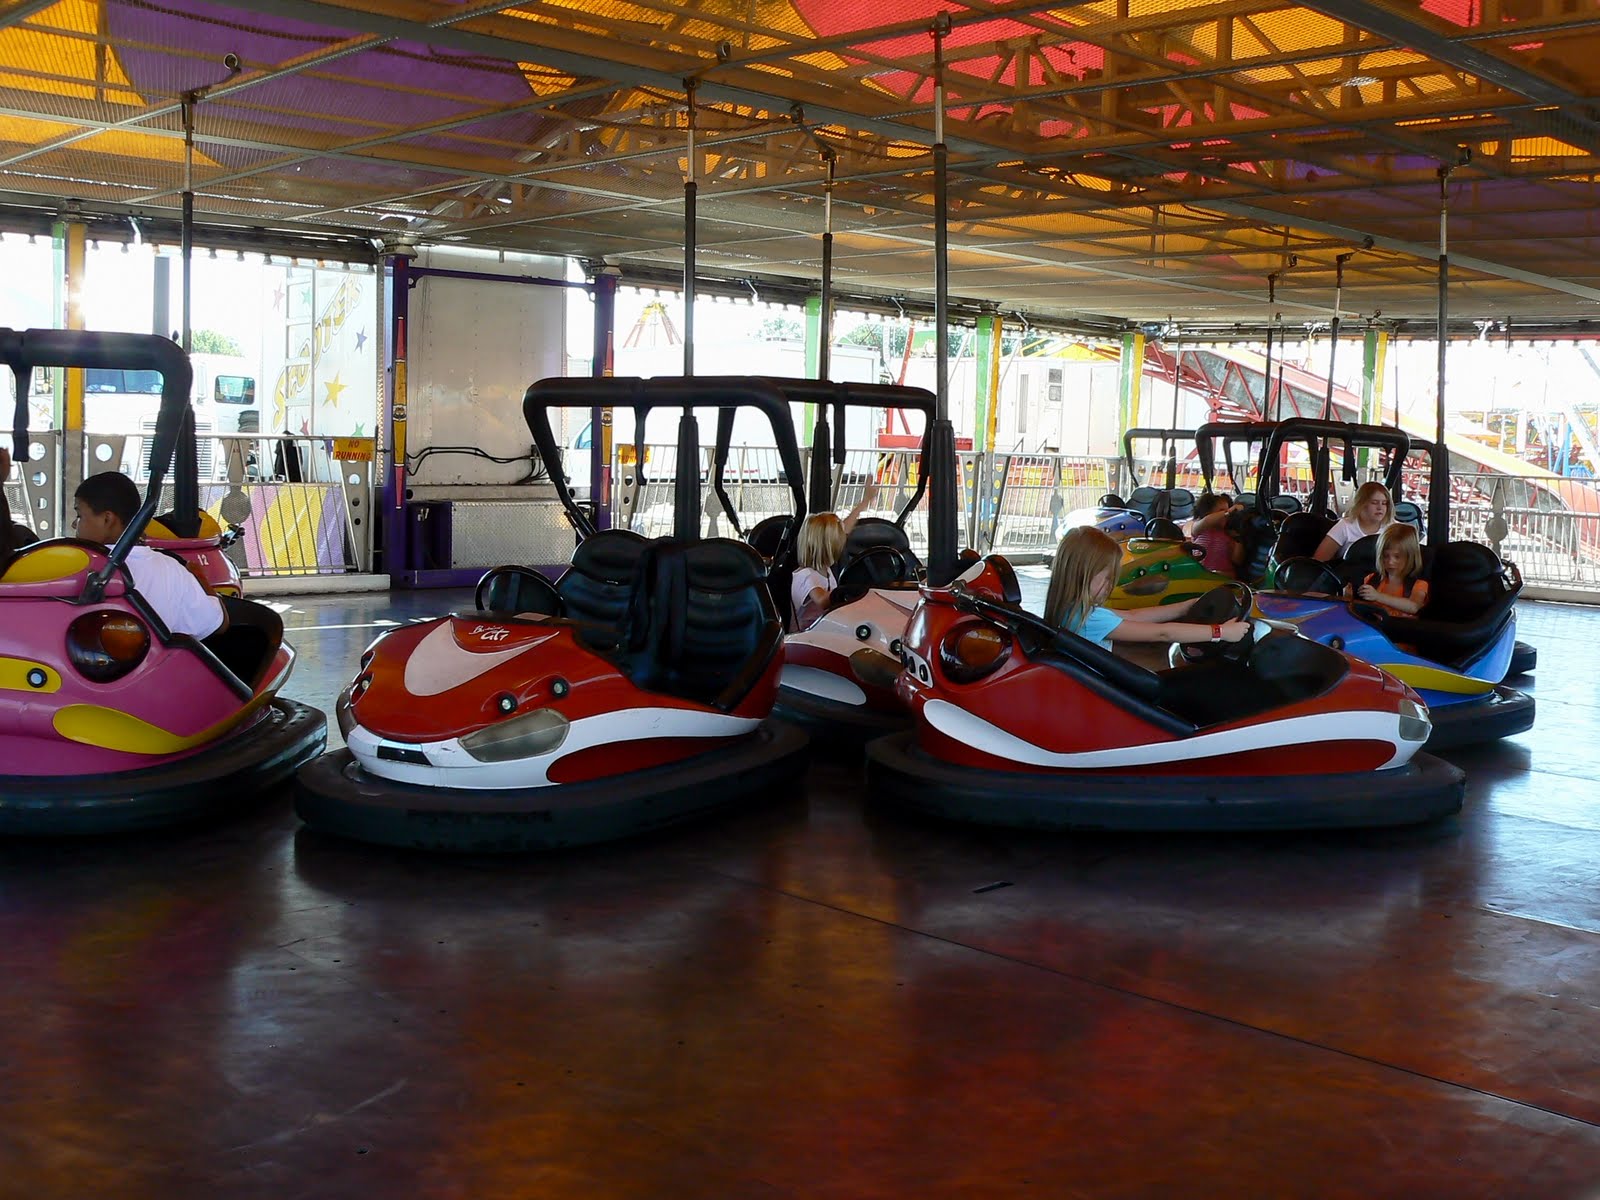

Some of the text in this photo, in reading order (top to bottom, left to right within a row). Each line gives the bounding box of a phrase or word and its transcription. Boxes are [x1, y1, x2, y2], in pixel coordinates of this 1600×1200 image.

[348, 440, 360, 449] NO
[335, 451, 373, 461] RUNNING
[197, 554, 209, 566] 12
